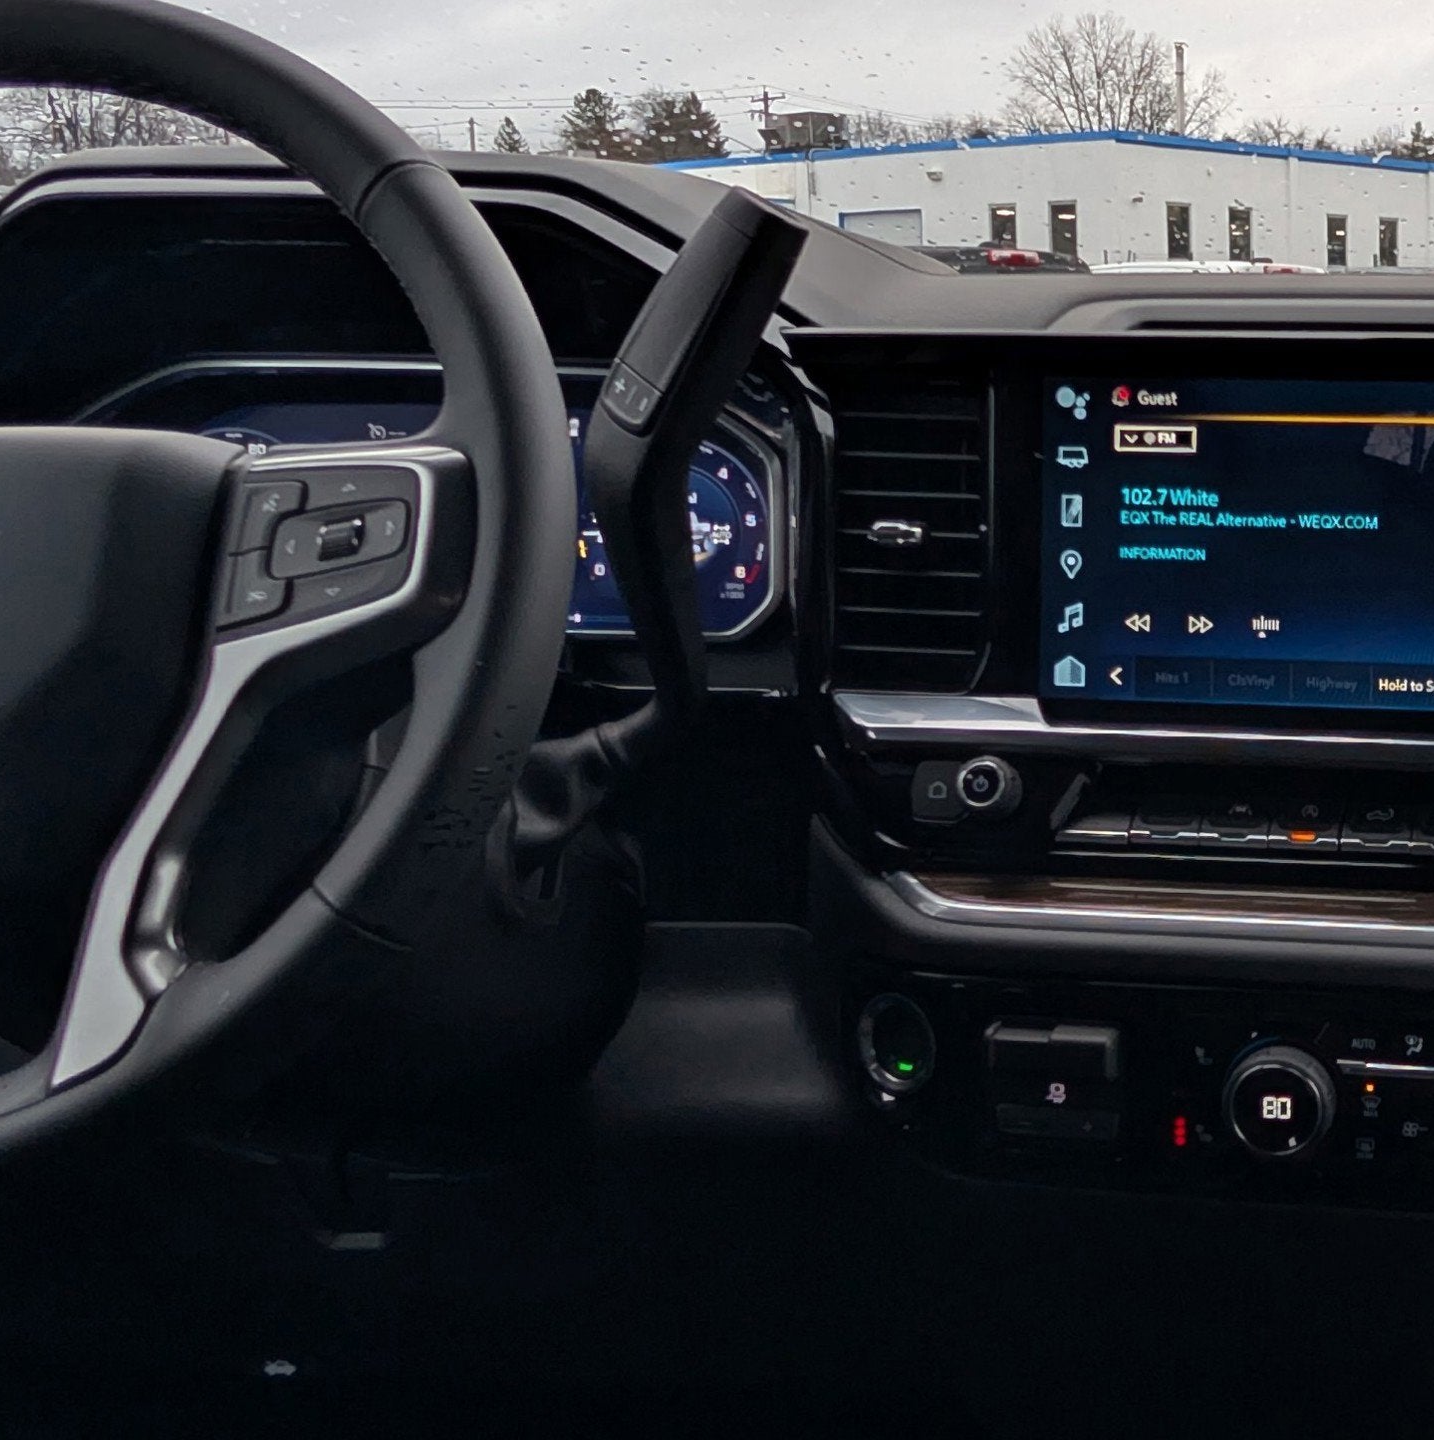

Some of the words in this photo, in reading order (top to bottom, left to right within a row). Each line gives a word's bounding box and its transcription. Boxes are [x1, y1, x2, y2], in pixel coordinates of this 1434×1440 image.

[1137, 389, 1178, 407] Guest
[1157, 431, 1177, 445] FM
[1121, 488, 1168, 506] 102.7
[1170, 489, 1219, 507] White
[1120, 510, 1150, 526] EQX
[1152, 511, 1176, 526] The
[1179, 511, 1214, 527] REAL
[1216, 513, 1287, 528] Alternative
[1298, 514, 1378, 530] WEQX.COM
[1119, 547, 1206, 561] INFORMATION
[1378, 678, 1408, 692] Hold
[1410, 680, 1423, 693] to
[1350, 1038, 1377, 1050] AUTO
[1262, 1095, 1292, 1120] 80
